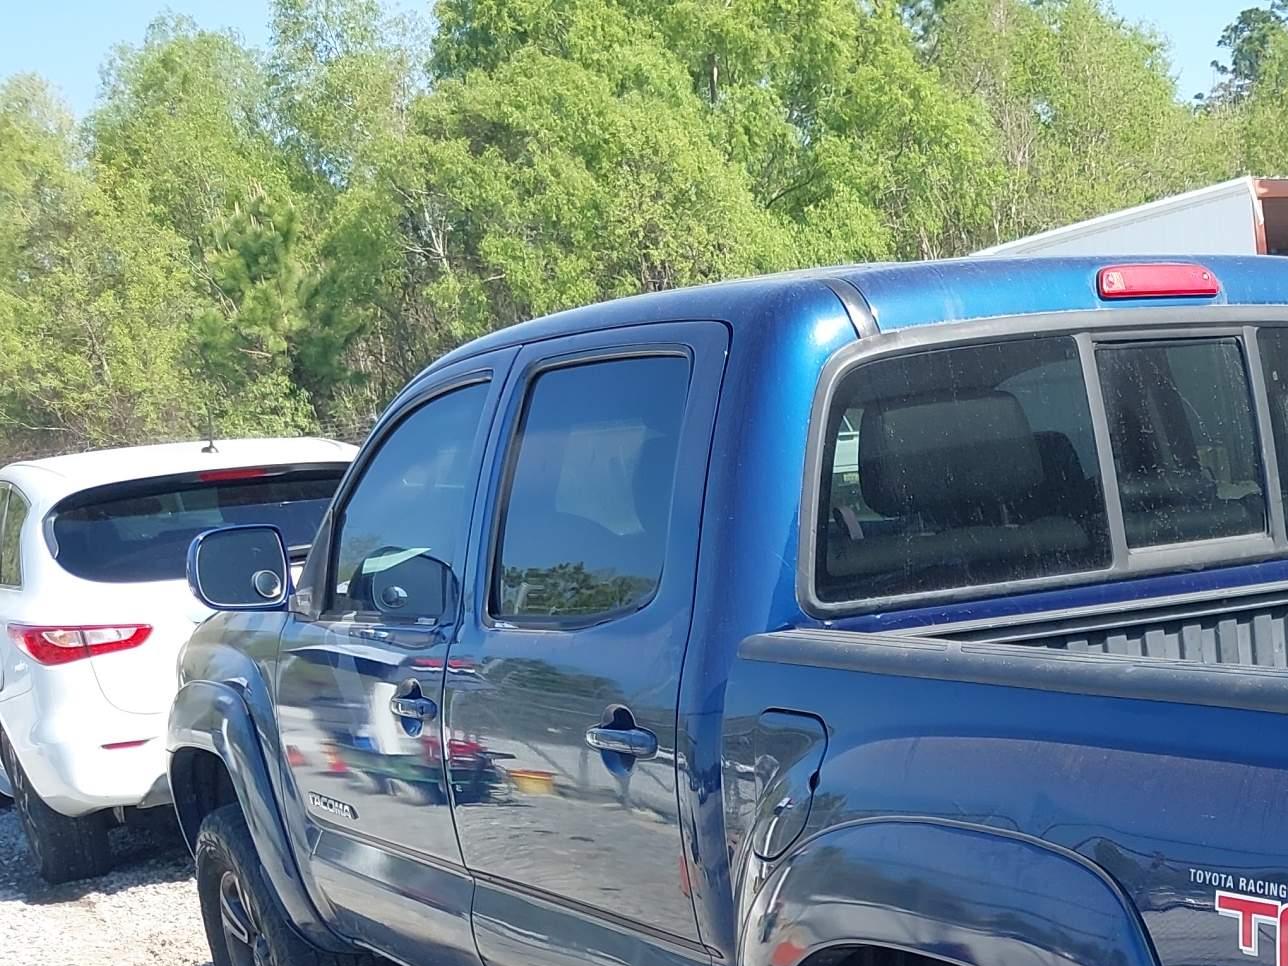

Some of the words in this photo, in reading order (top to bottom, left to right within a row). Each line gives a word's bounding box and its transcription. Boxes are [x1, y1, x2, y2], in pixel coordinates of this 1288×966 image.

[308, 792, 353, 819] TACOMA
[1189, 868, 1234, 889] TOYOTA
[1238, 877, 1287, 898] RACING
